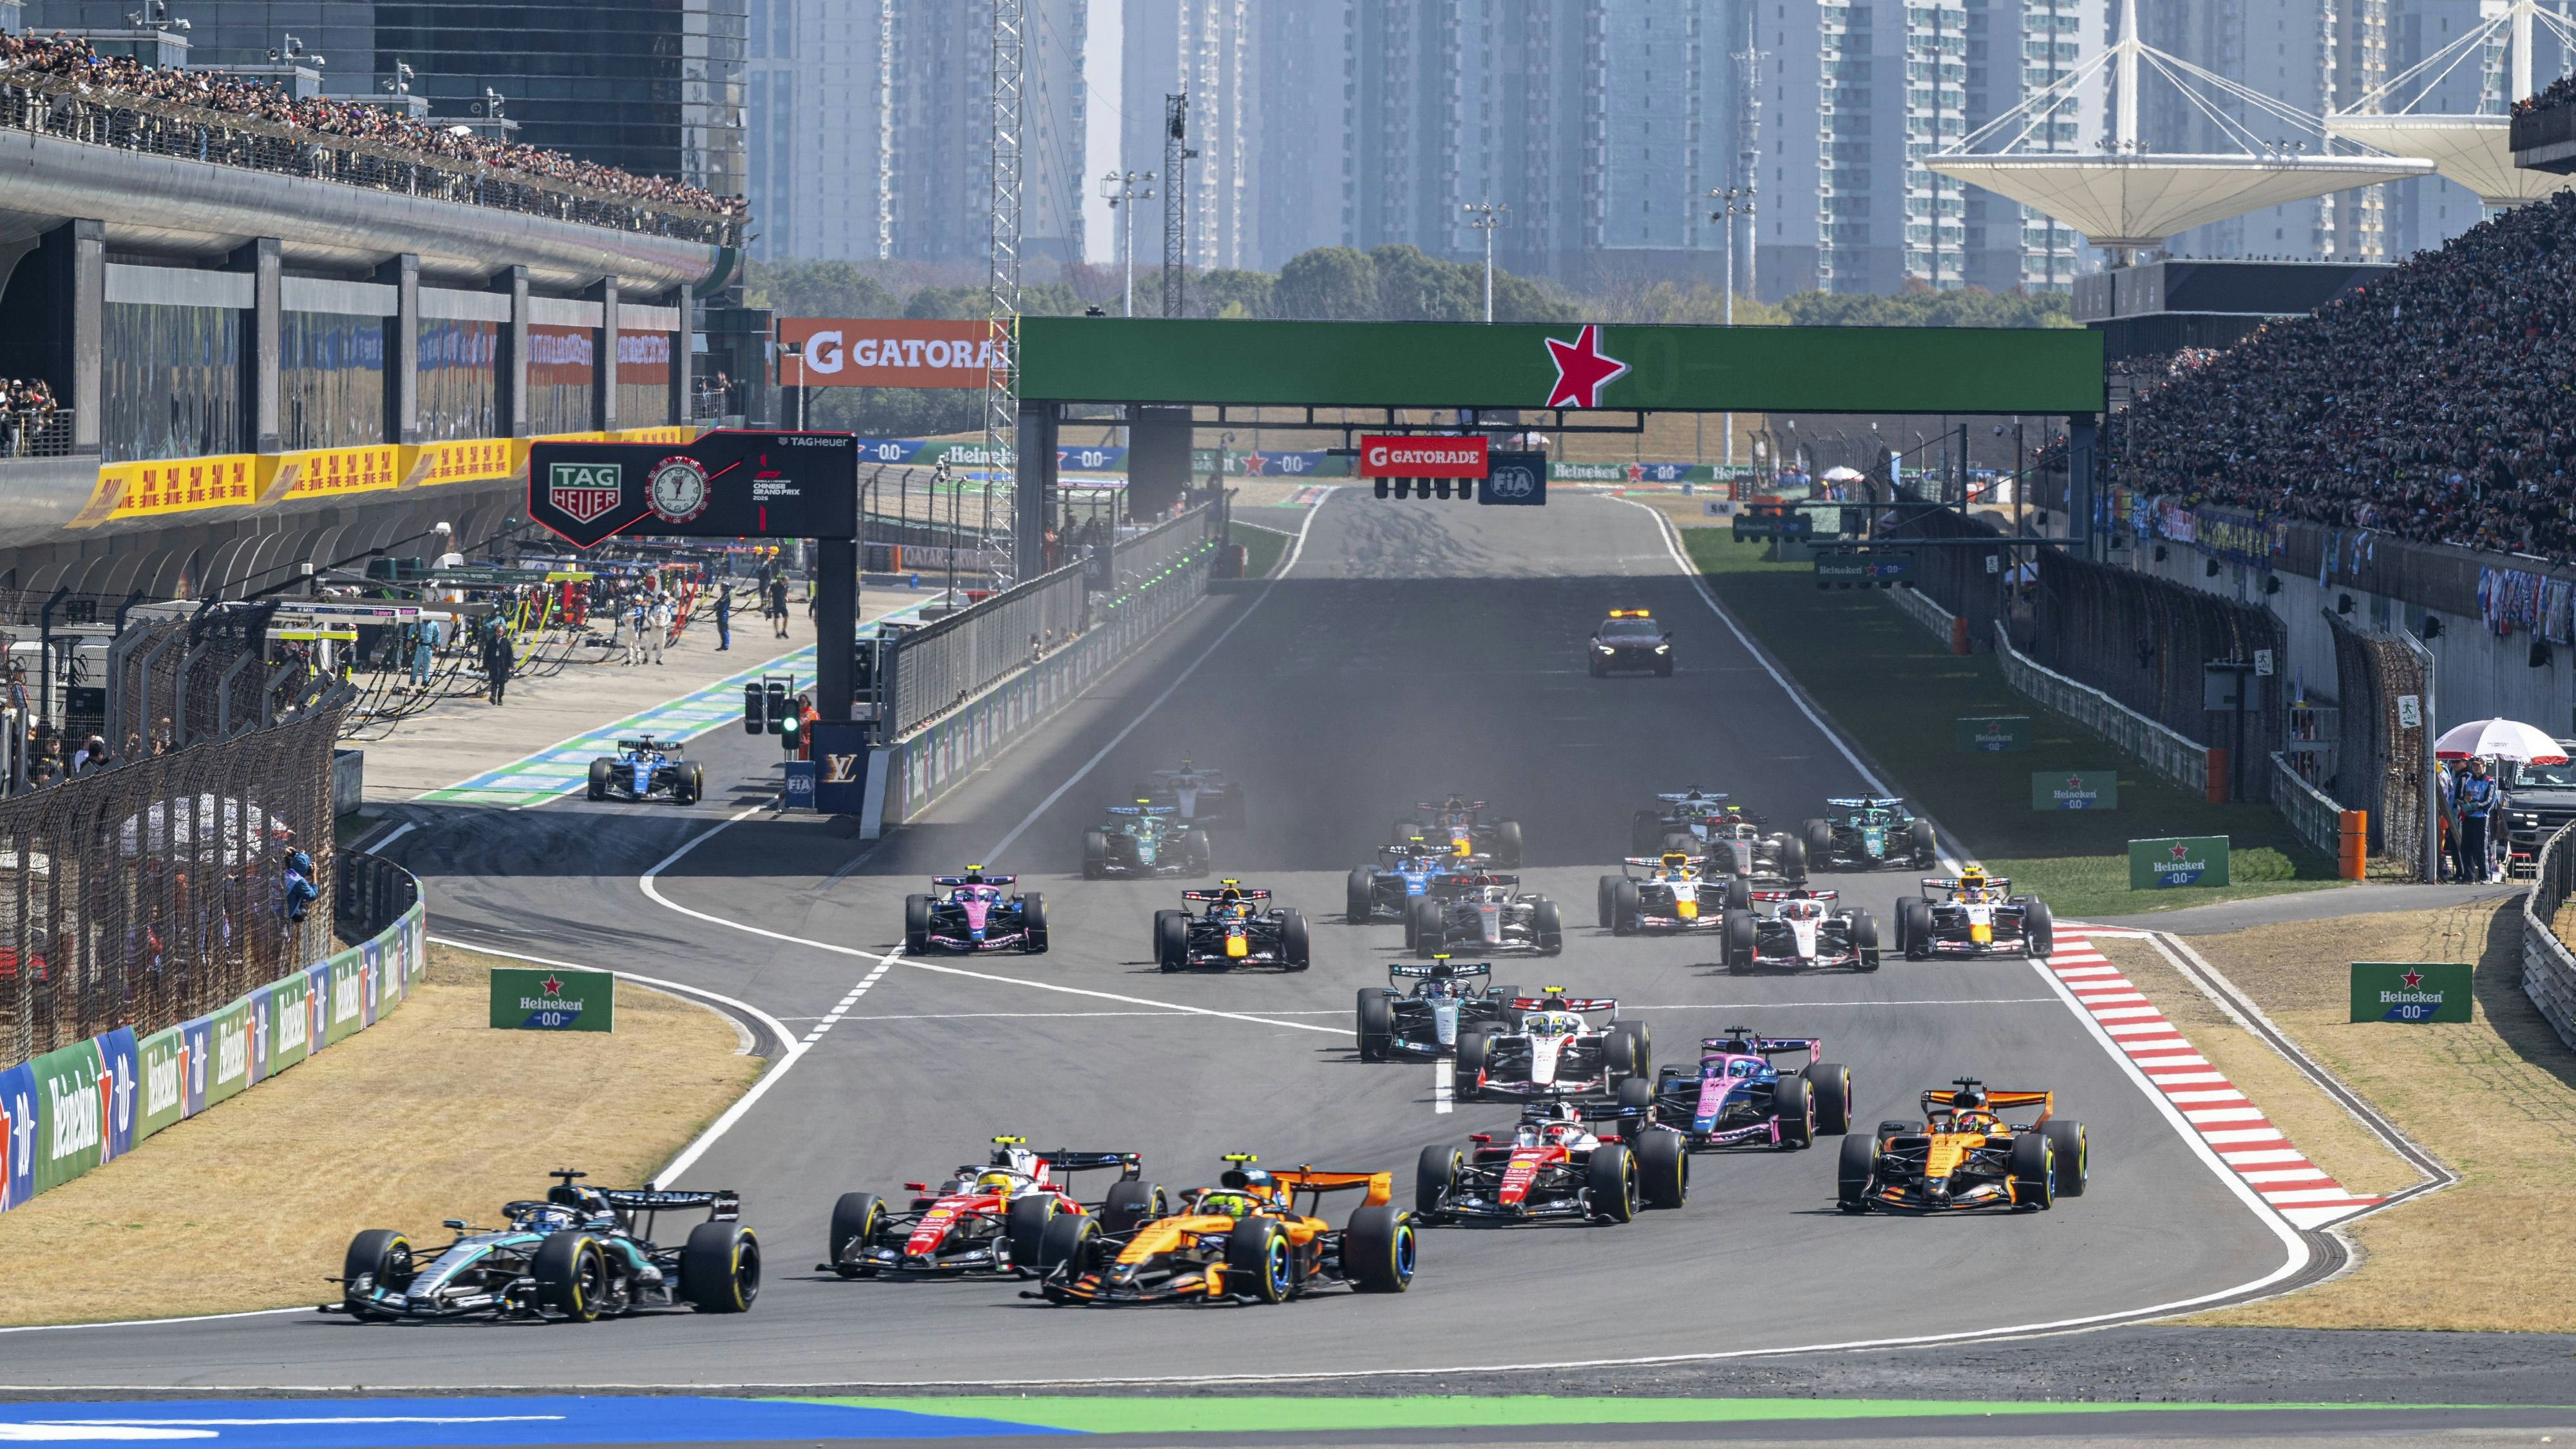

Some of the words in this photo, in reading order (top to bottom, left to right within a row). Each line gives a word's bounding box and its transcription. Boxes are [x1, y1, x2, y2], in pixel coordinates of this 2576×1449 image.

[853, 339, 1008, 368] GATORA
[1391, 451, 1478, 464] GATORADE
[556, 468, 614, 486] TAG
[554, 491, 616, 518] HEUER
[1819, 565, 1862, 574] Heineken
[2053, 790, 2096, 799] Heineken
[2154, 860, 2204, 872] Heineken
[2173, 873, 2188, 884] 0.0
[2380, 991, 2443, 1003] Heineken
[520, 998, 583, 1010] Heineken
[2402, 1005, 2421, 1018] 0.0
[279, 989, 305, 1054] Heineken
[542, 1012, 561, 1026] 0.0
[217, 1016, 245, 1085] Heineken
[147, 1045, 177, 1117] Heineken
[48, 1070, 98, 1160] Heineken
